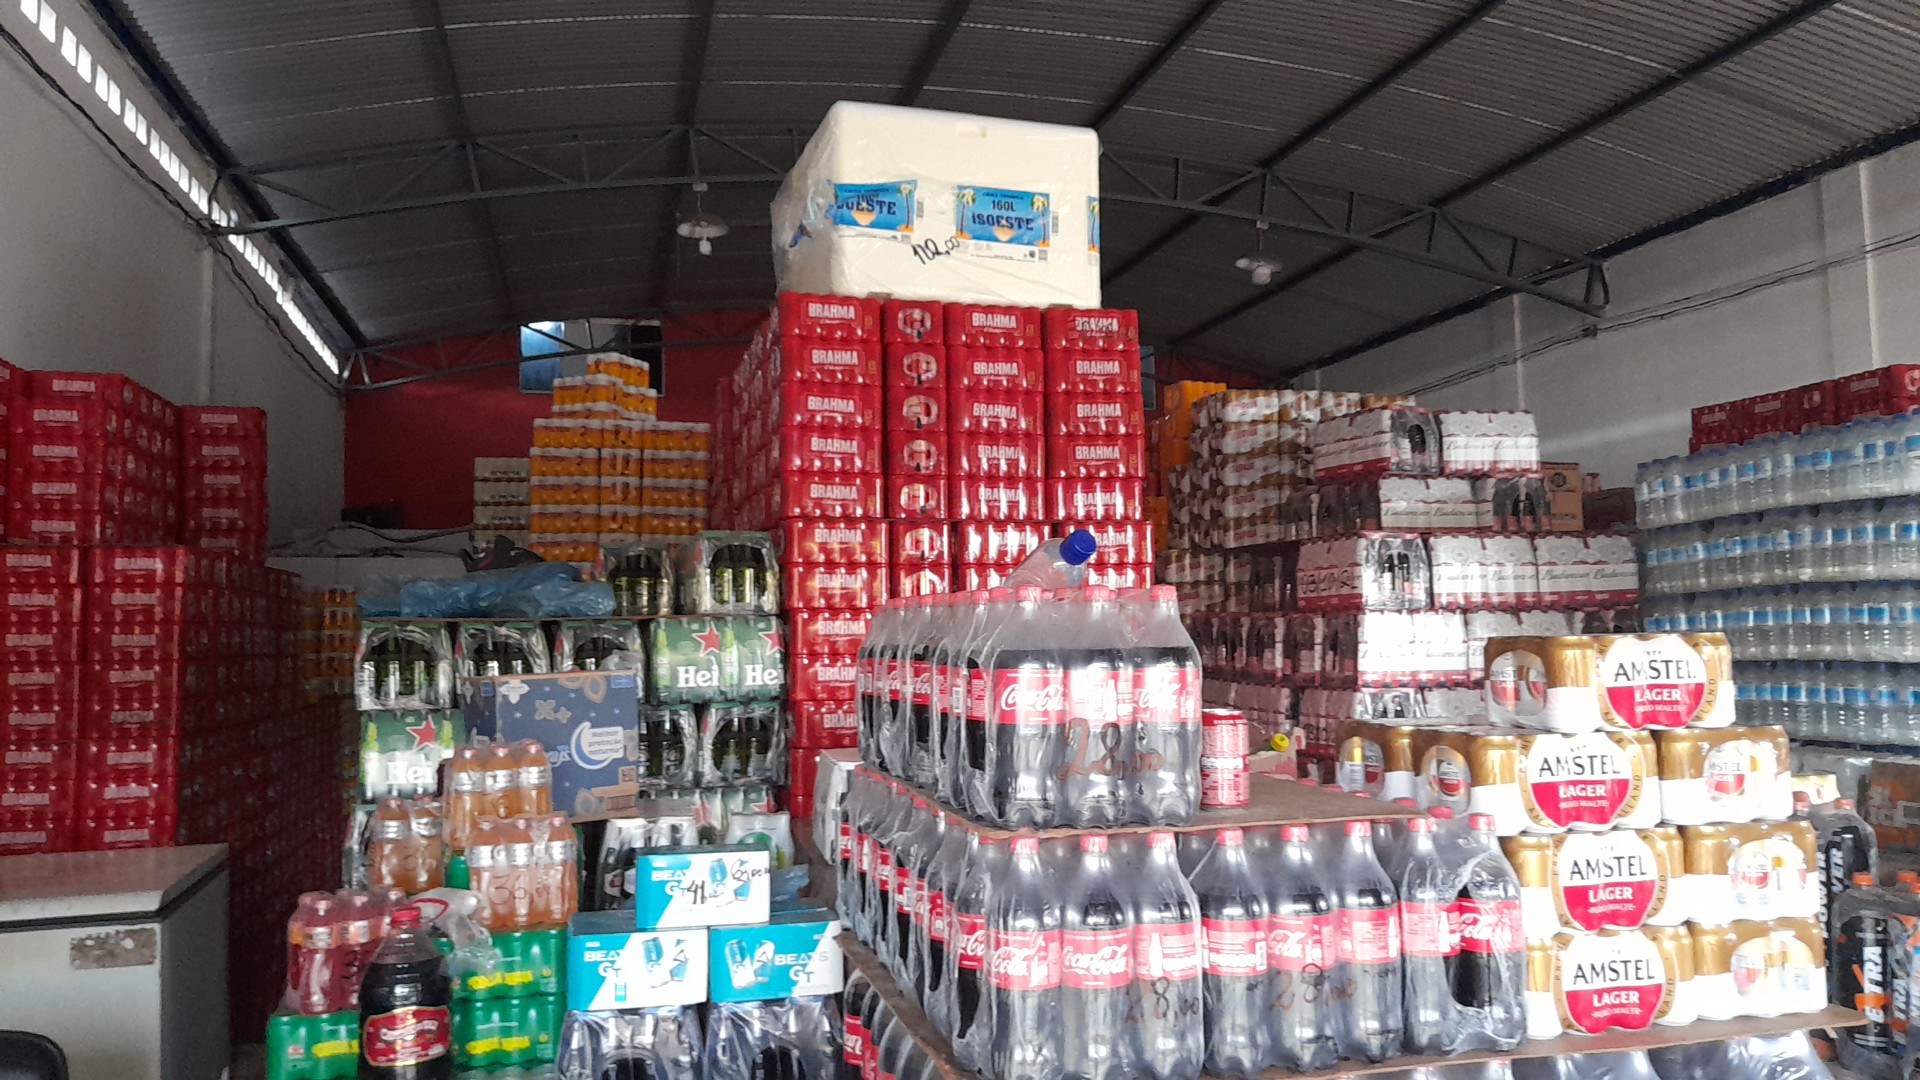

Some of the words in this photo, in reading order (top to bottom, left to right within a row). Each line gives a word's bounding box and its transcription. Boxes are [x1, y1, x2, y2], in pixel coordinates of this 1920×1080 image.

[971, 211, 1035, 231] ISOESTE
[808, 303, 856, 320] BRAHMA
[972, 312, 1017, 329] BRAHMA
[812, 349, 859, 366] BRAHMA
[973, 361, 1019, 376] BRAHMA
[1076, 360, 1121, 375] BRAHMA
[807, 395, 855, 413] BRAHMA
[972, 402, 1018, 419] BRAHMA
[1076, 403, 1122, 418] BRAHMA
[811, 437, 858, 454] BRAHMA
[977, 444, 1021, 460] BRAHMA
[1075, 445, 1120, 460] BRAHMA
[810, 483, 858, 500] BRAHMA
[813, 528, 863, 543] BRAHMA
[817, 620, 867, 635] BRAHMA
[677, 663, 720, 687] Hei
[1613, 659, 1698, 682] AMSTEL
[1634, 688, 1682, 702] LAGER
[1539, 754, 1621, 777] AMSTEL
[1558, 784, 1607, 798] LAGER
[1570, 855, 1647, 880] AMSTEL
[1588, 886, 1634, 903] LAGER
[1573, 958, 1655, 985] AMSTEL
[1592, 990, 1640, 1007] LAGER
